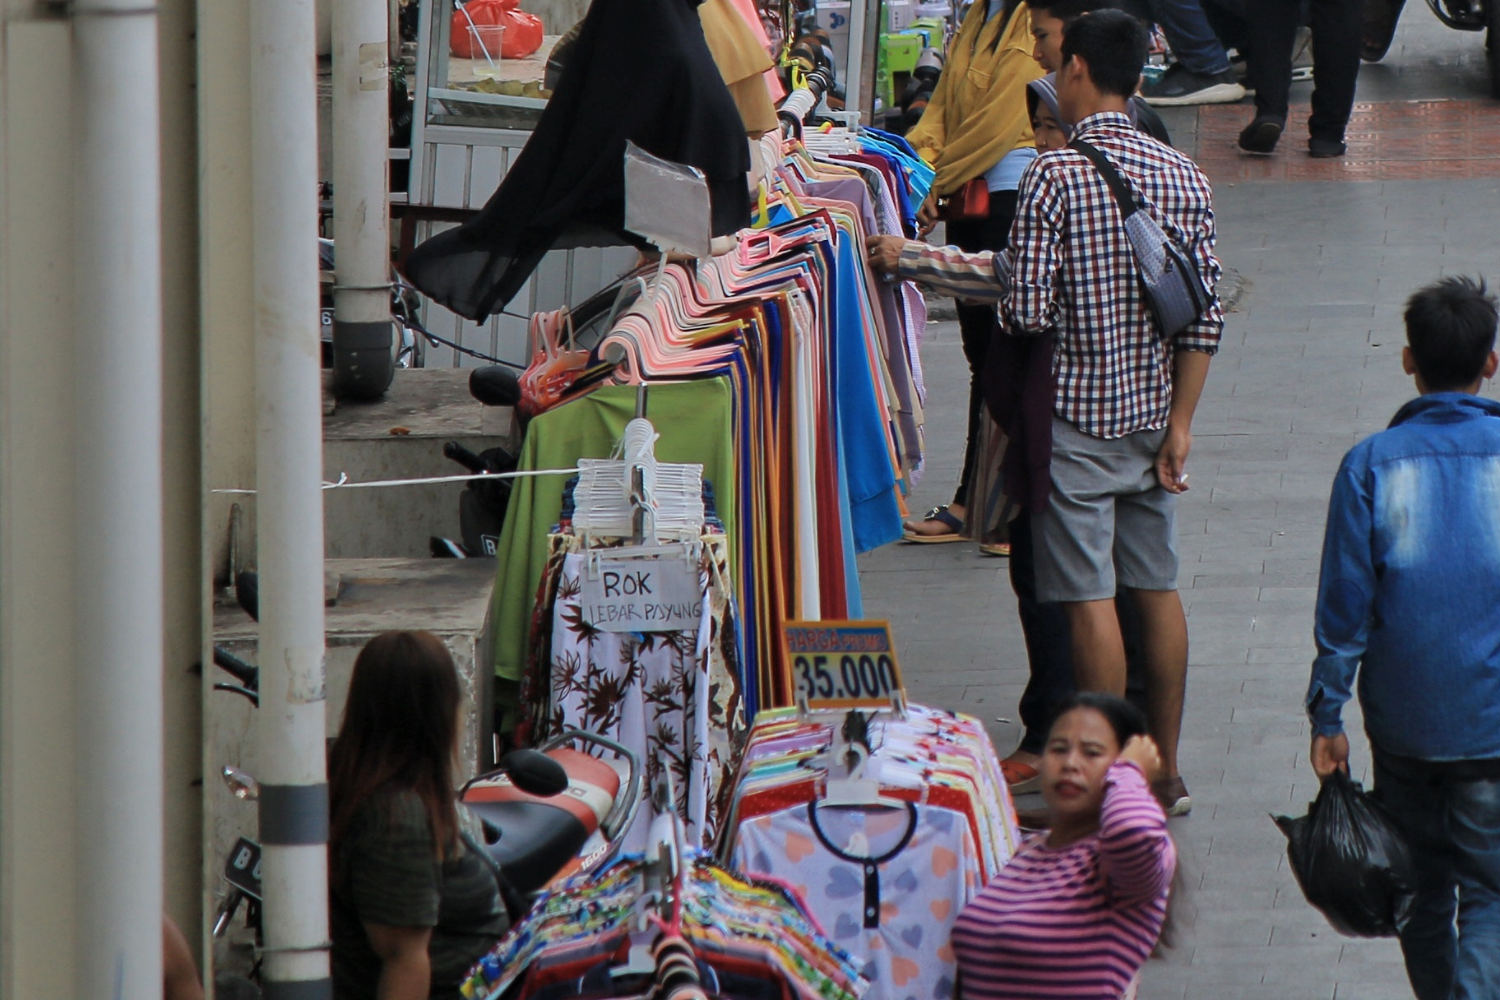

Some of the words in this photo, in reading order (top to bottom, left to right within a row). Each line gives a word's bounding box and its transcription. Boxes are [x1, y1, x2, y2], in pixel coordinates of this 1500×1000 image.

[603, 571, 652, 598] ROK
[589, 602, 642, 626] LEBAR
[644, 602, 701, 622] PAYUNG
[786, 628, 840, 652] HARGA
[795, 654, 899, 699] 35.000
